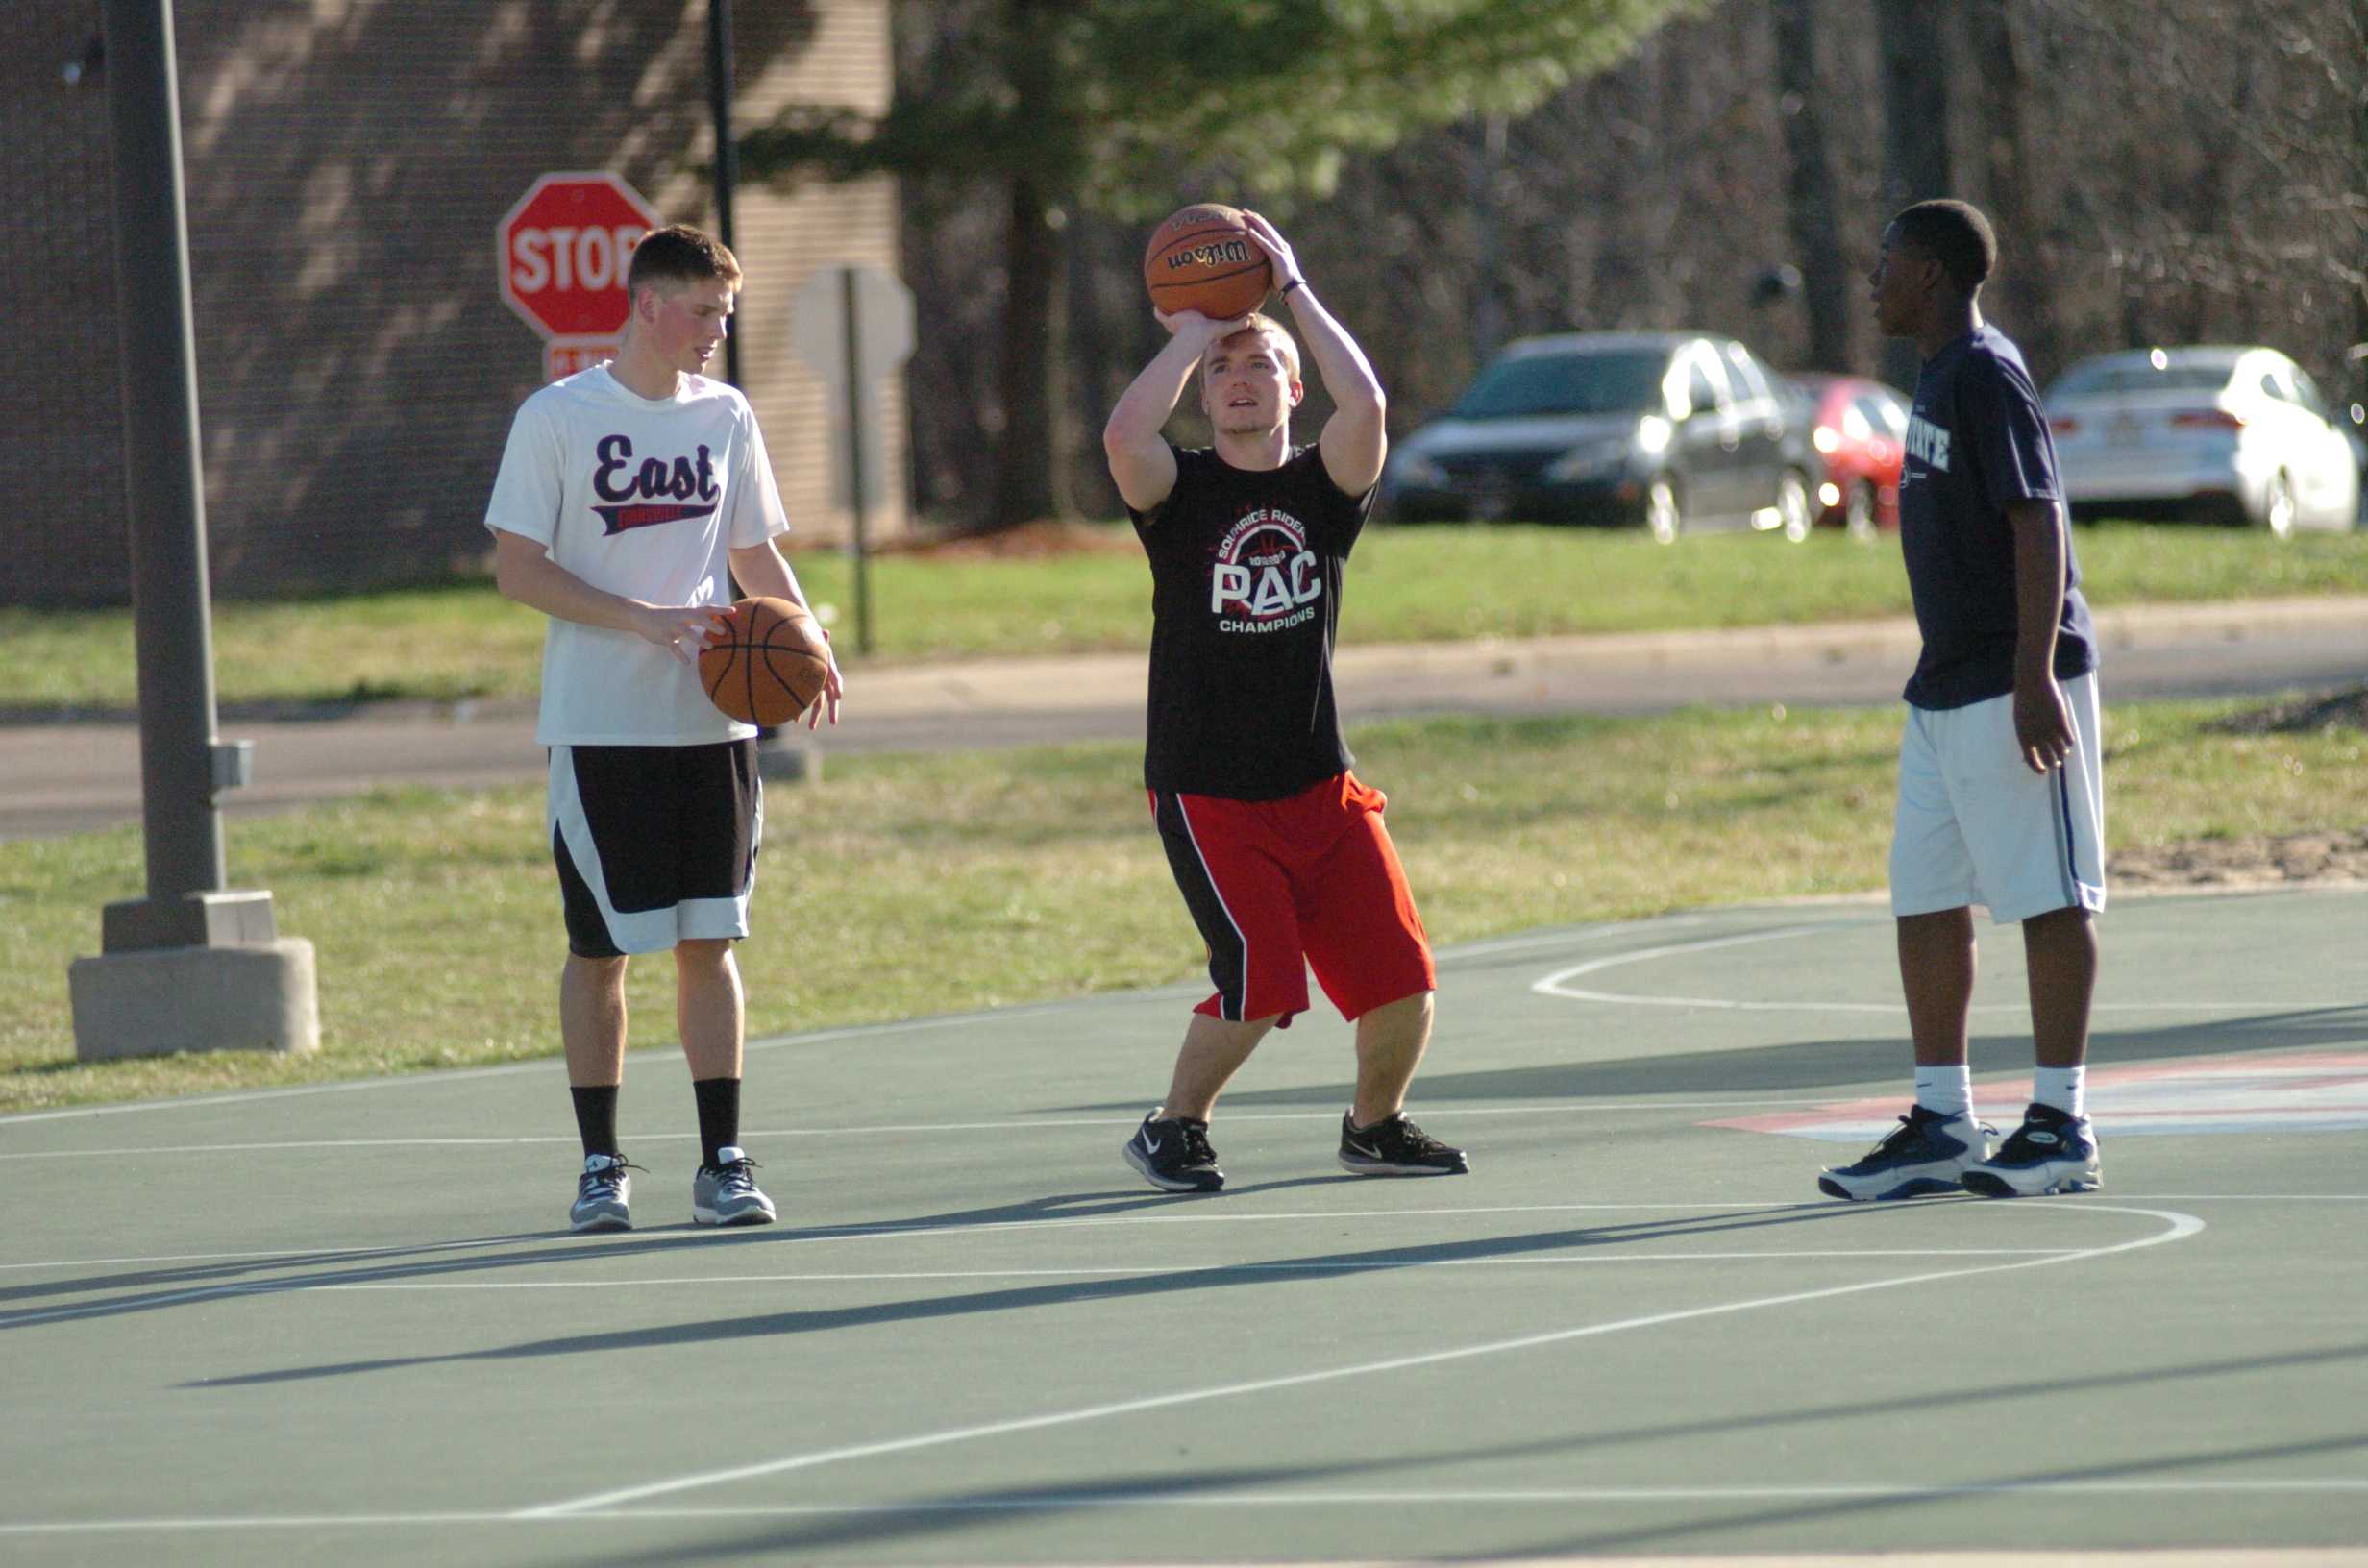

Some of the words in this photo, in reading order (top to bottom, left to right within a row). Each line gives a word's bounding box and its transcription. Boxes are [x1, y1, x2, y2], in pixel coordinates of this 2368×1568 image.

[513, 225, 645, 292] STOP
[1167, 240, 1250, 270] Wilson
[593, 434, 721, 502] East
[1211, 550, 1322, 616] PAC
[1219, 606, 1316, 634] CHAMPIONS
